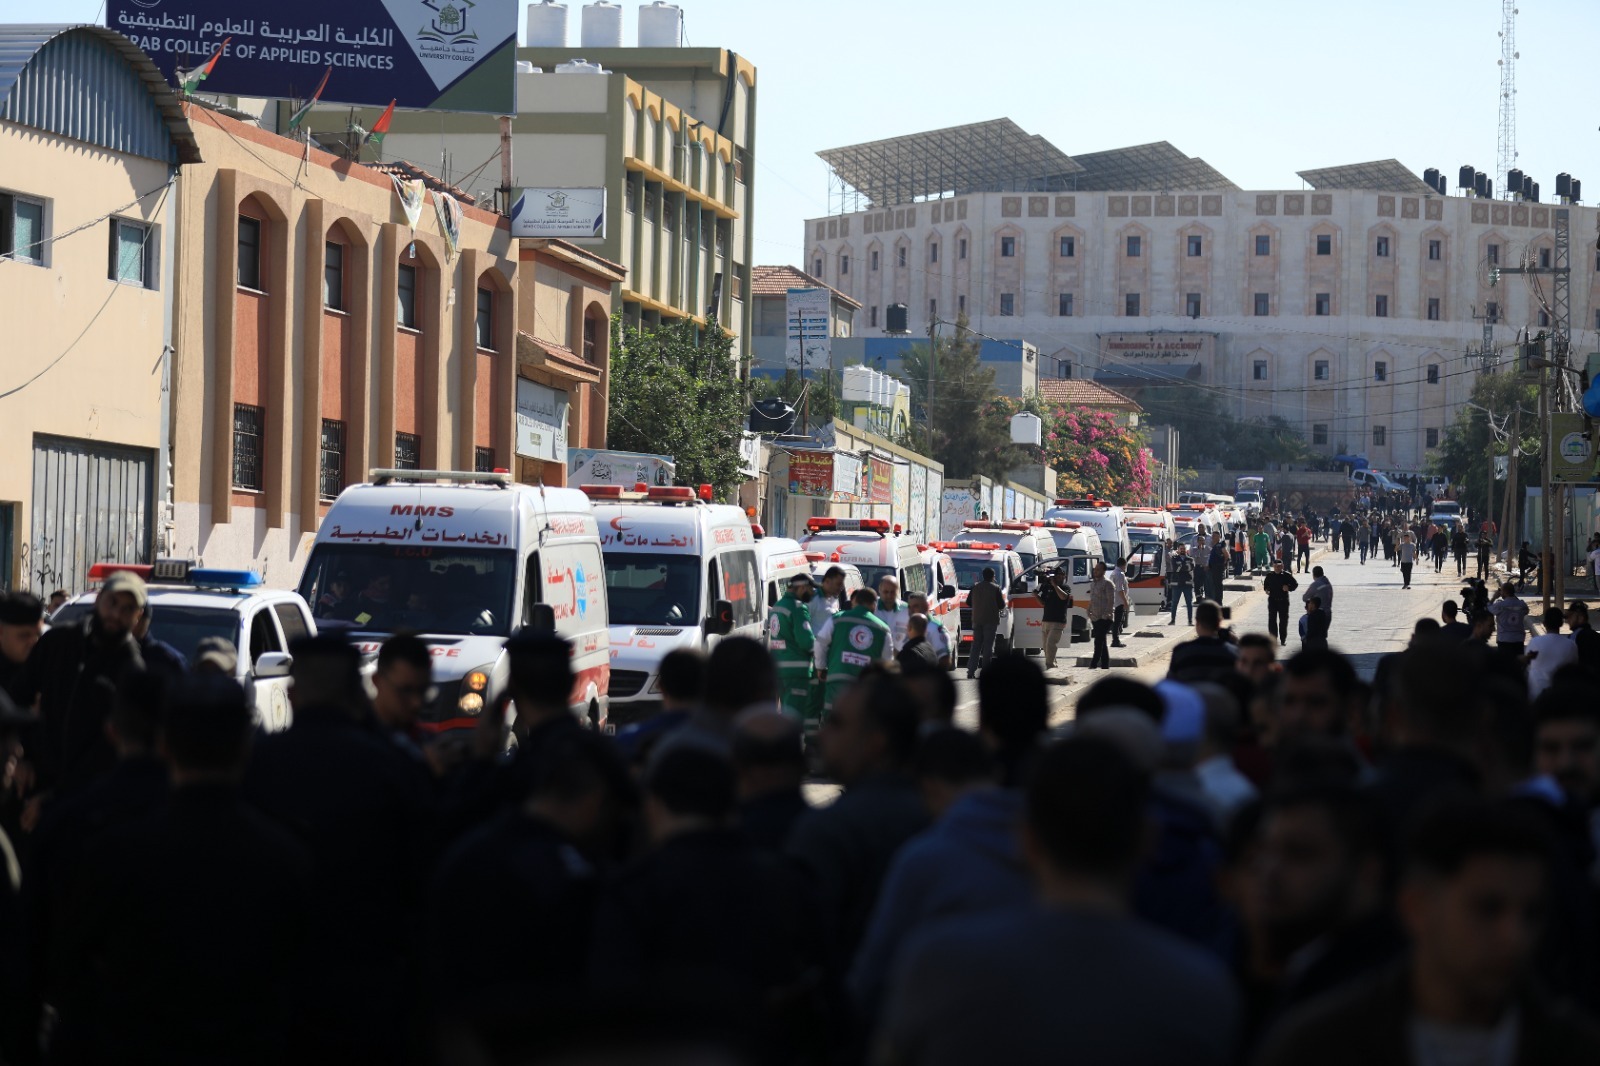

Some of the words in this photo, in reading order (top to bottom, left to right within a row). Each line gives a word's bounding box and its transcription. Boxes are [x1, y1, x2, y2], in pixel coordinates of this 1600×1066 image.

[118, 10, 195, 31] التطبيقية
[199, 18, 254, 38] للعلوم
[260, 21, 329, 44] العربية
[335, 27, 393, 48] الكلية
[129, 34, 161, 51] RAB
[164, 38, 231, 57] COLLEGE
[236, 44, 256, 58] OF
[259, 47, 321, 65] APPLIED
[324, 51, 394, 70] SCIENCES
[420, 52, 451, 60] UNIVERSITY
[390, 504, 455, 517] MMS
[330, 525, 413, 542] الطبية
[421, 528, 508, 546] الخدمات
[623, 534, 694, 547] الخدمات
